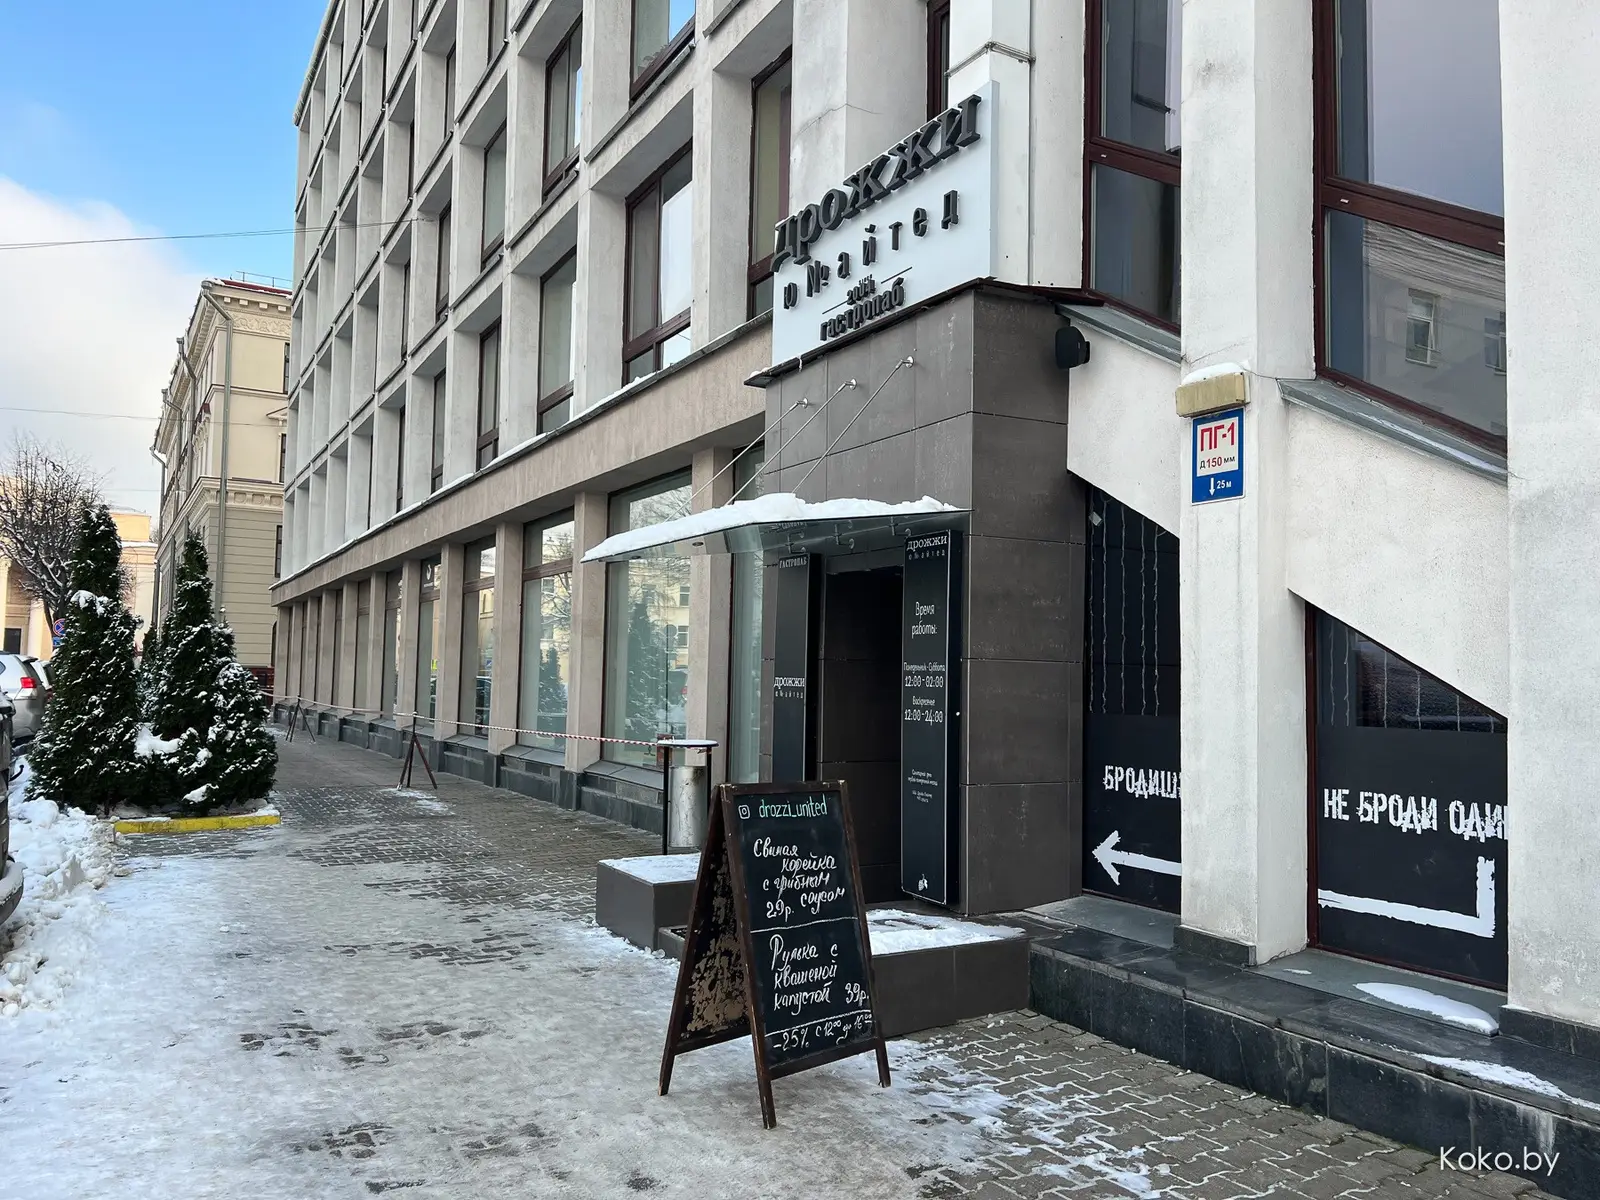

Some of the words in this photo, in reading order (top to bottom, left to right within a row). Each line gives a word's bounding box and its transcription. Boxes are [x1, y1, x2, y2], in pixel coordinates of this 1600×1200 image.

[1200, 421, 1235, 452] ПГ-1
[915, 601, 935, 620] Время
[1103, 764, 1182, 799] БРОДИШ
[759, 794, 828, 818] drozzi_united
[1323, 788, 1350, 821] НЕ
[1355, 791, 1438, 835] БРОДИ
[753, 836, 799, 858] Свиная
[781, 852, 837, 878] корейка
[774, 871, 830, 899] грибным
[800, 886, 845, 915] соусом
[769, 934, 819, 971] Рулька
[830, 943, 839, 957] с
